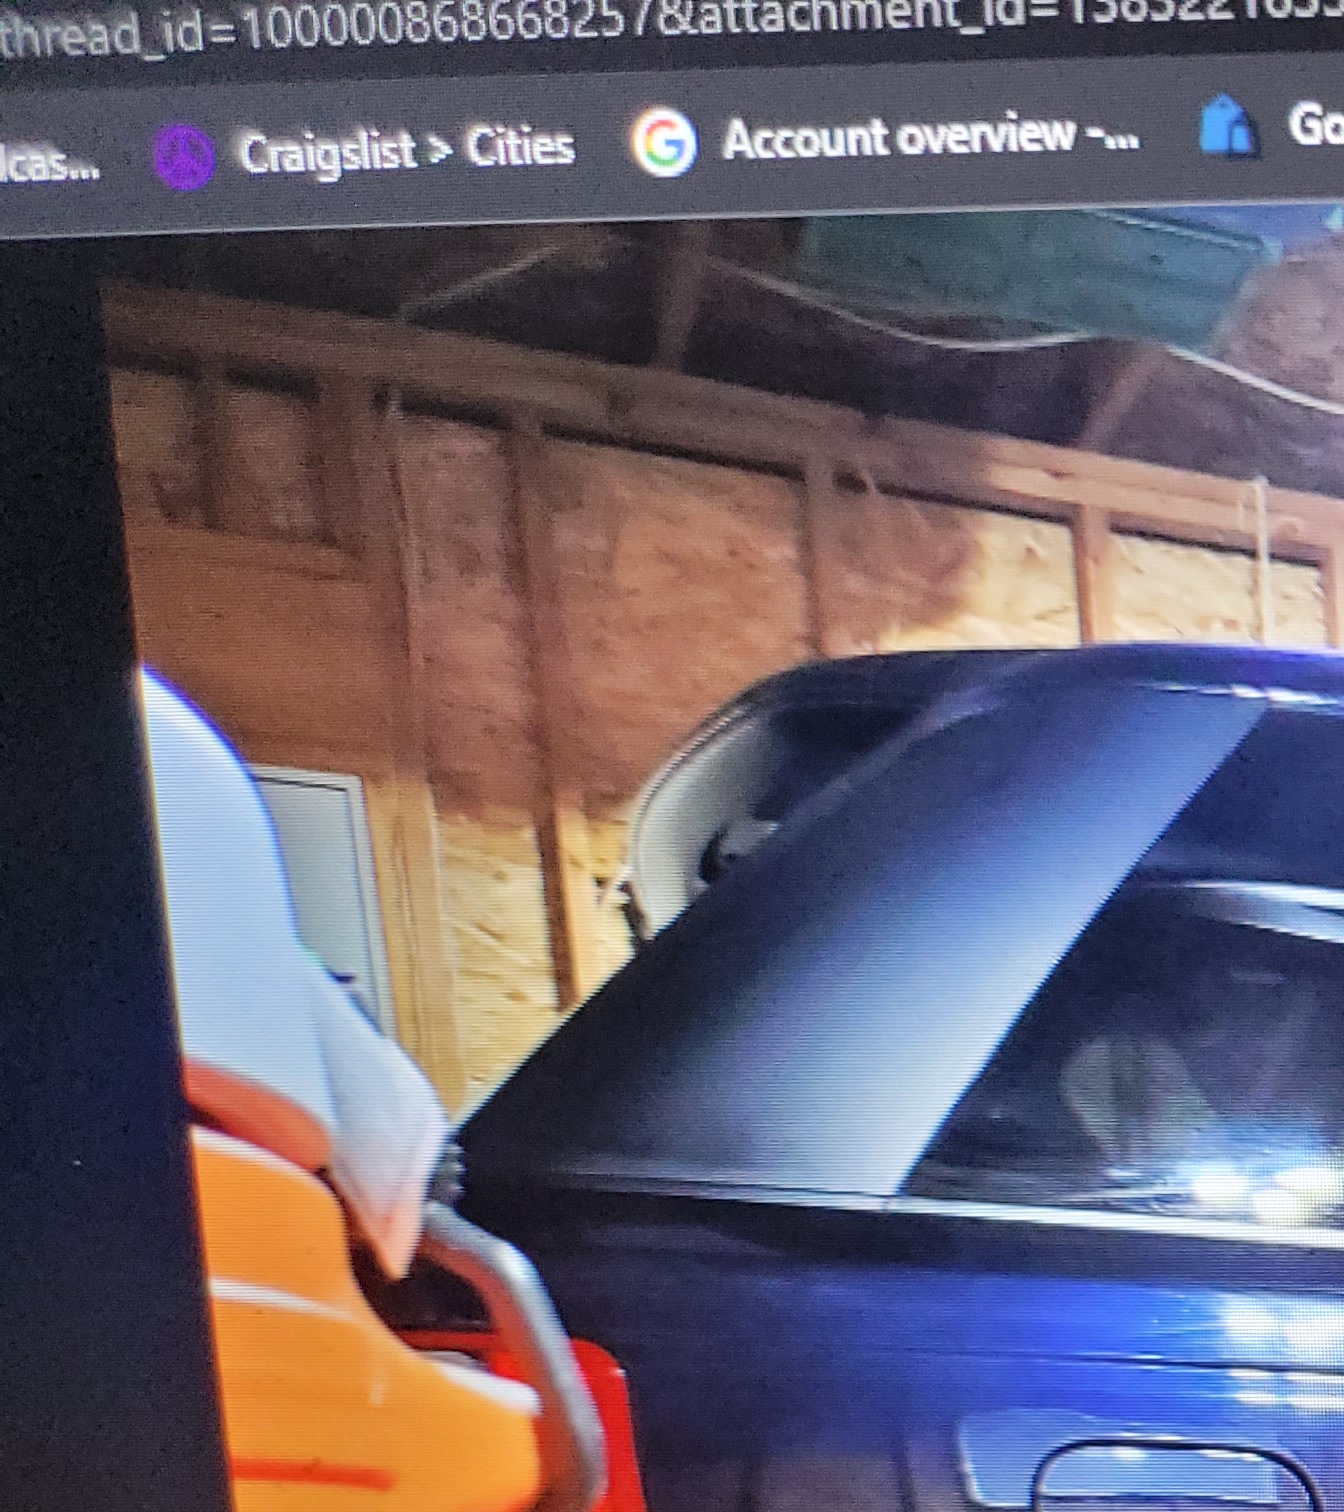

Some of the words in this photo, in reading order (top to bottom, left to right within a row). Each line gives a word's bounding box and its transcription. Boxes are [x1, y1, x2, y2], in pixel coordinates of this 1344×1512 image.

[235, 126, 419, 183] Craigslist
[426, 134, 454, 164] >
[462, 122, 576, 167] Cities
[721, 117, 892, 160] Account
[895, 108, 1078, 155] overview
